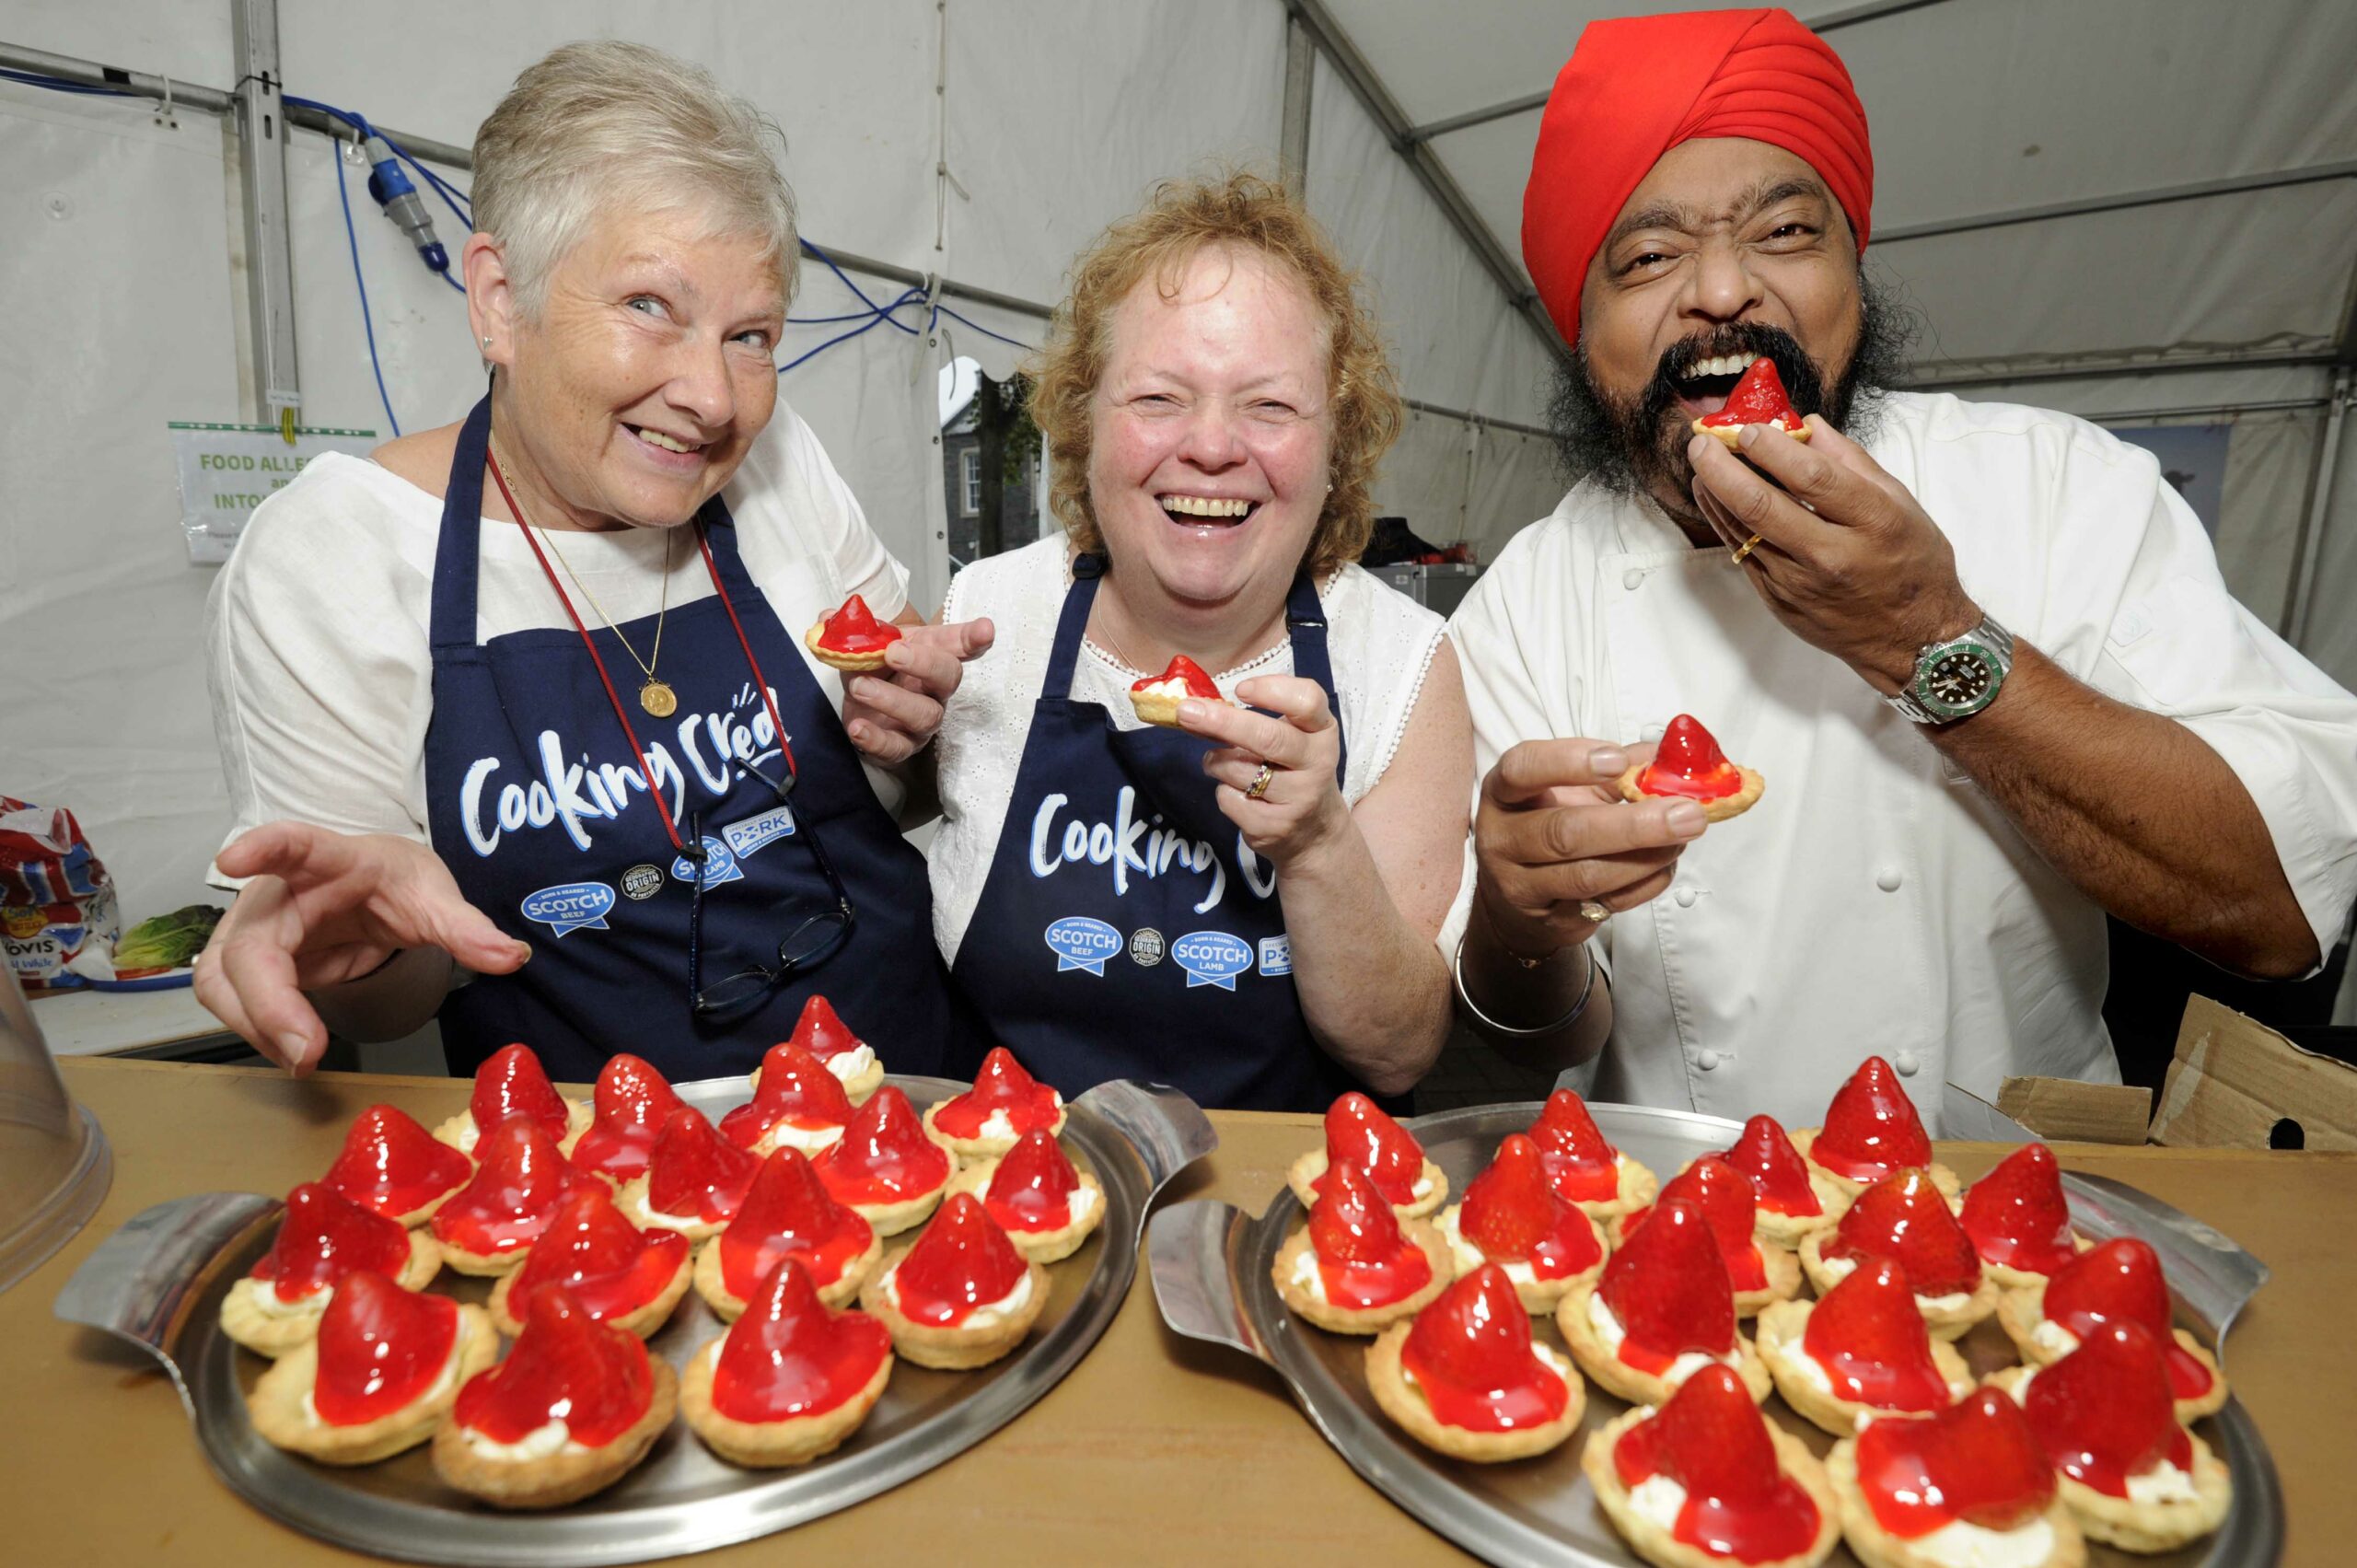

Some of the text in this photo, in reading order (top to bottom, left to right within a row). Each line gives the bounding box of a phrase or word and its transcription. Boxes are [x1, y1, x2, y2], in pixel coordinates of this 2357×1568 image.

[200, 454, 311, 471] FOOD ALLE
[460, 685, 792, 858] Cooking Cred
[1029, 785, 1225, 913] Cooking
[704, 860, 726, 876] LAMB
[626, 873, 659, 891] ORIGIN
[528, 889, 610, 916] SCOTCH
[560, 911, 586, 919] BEEF
[1051, 928, 1117, 949] SCOTCH
[1071, 947, 1094, 956] BEEF
[1132, 941, 1161, 955] ORIGIN
[1178, 944, 1247, 963] SCOTCH
[1199, 962, 1225, 971] LAMB
